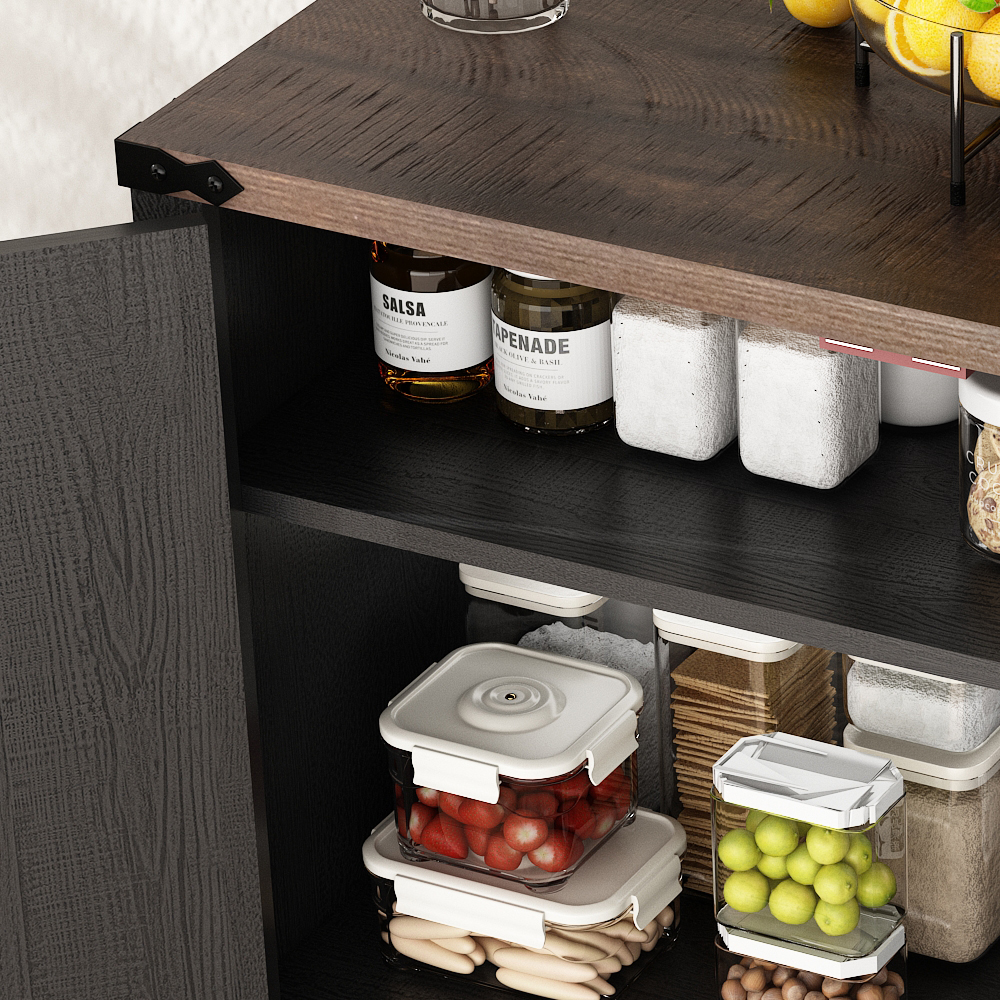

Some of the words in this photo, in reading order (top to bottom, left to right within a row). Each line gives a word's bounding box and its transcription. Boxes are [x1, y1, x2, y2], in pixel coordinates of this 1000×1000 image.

[382, 293, 426, 317] SALSA
[385, 348, 410, 361] Nicolas
[503, 383, 527, 398] Nicolas
